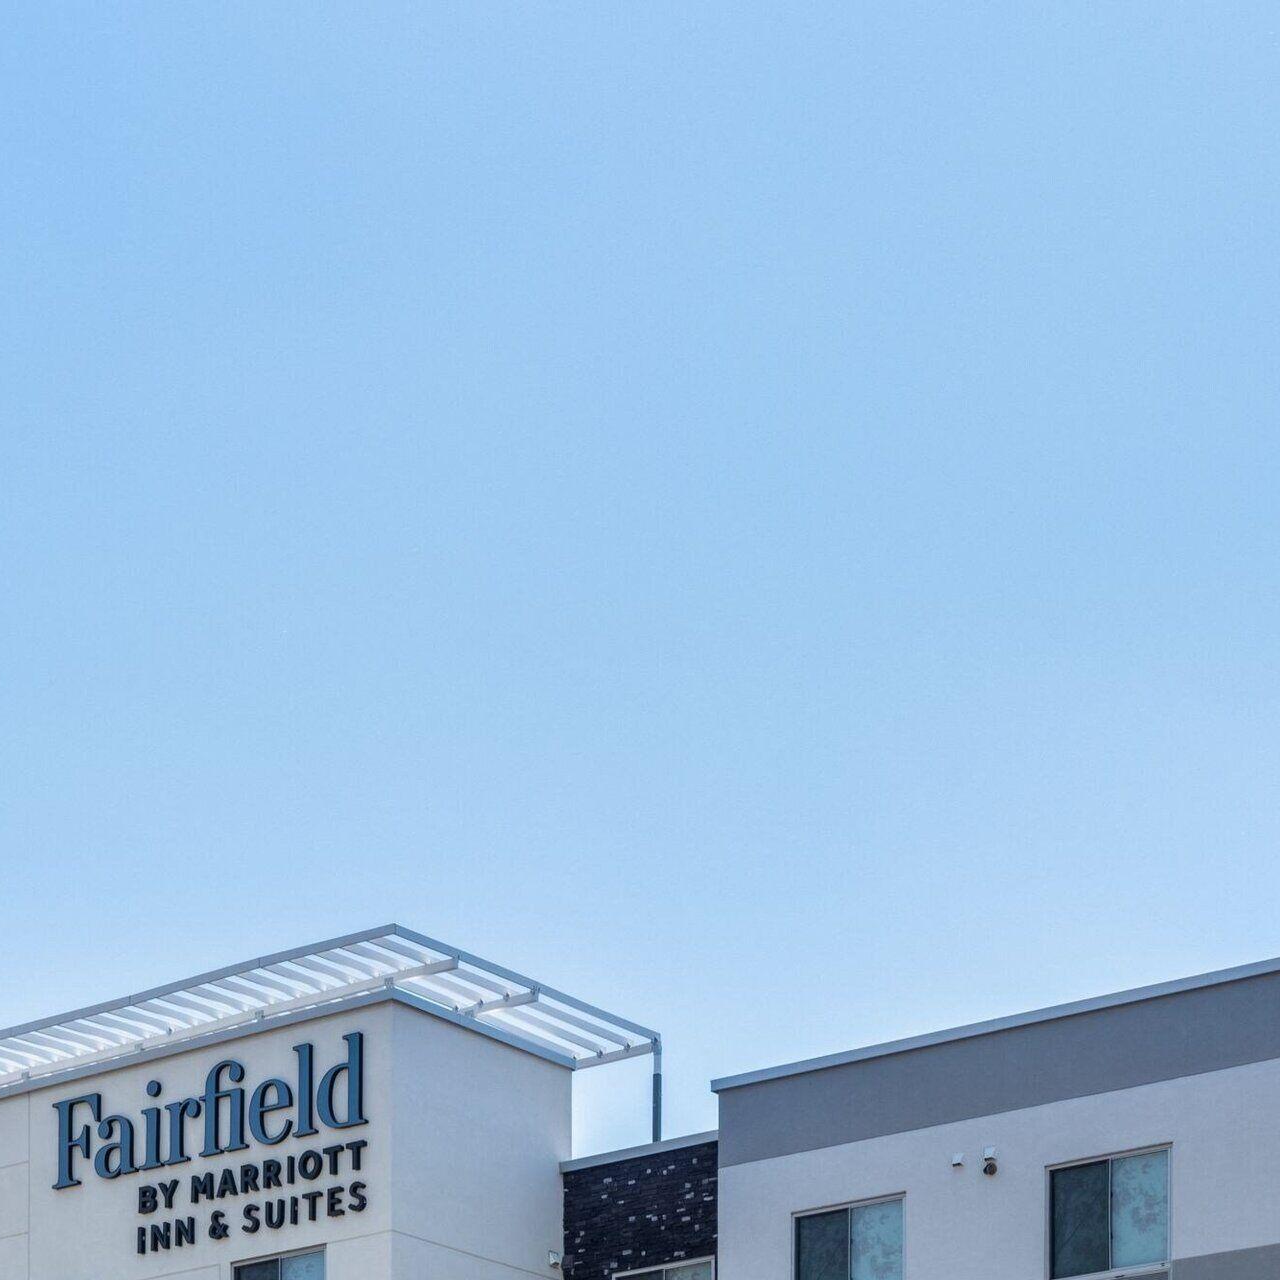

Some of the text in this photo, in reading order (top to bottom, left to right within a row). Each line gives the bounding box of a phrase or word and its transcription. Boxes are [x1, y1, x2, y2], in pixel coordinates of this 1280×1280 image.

[51, 1031, 369, 1190] Fairfield
[138, 1139, 368, 1215] BY MARRIOTT
[137, 1181, 368, 1255] INN & SUITES
